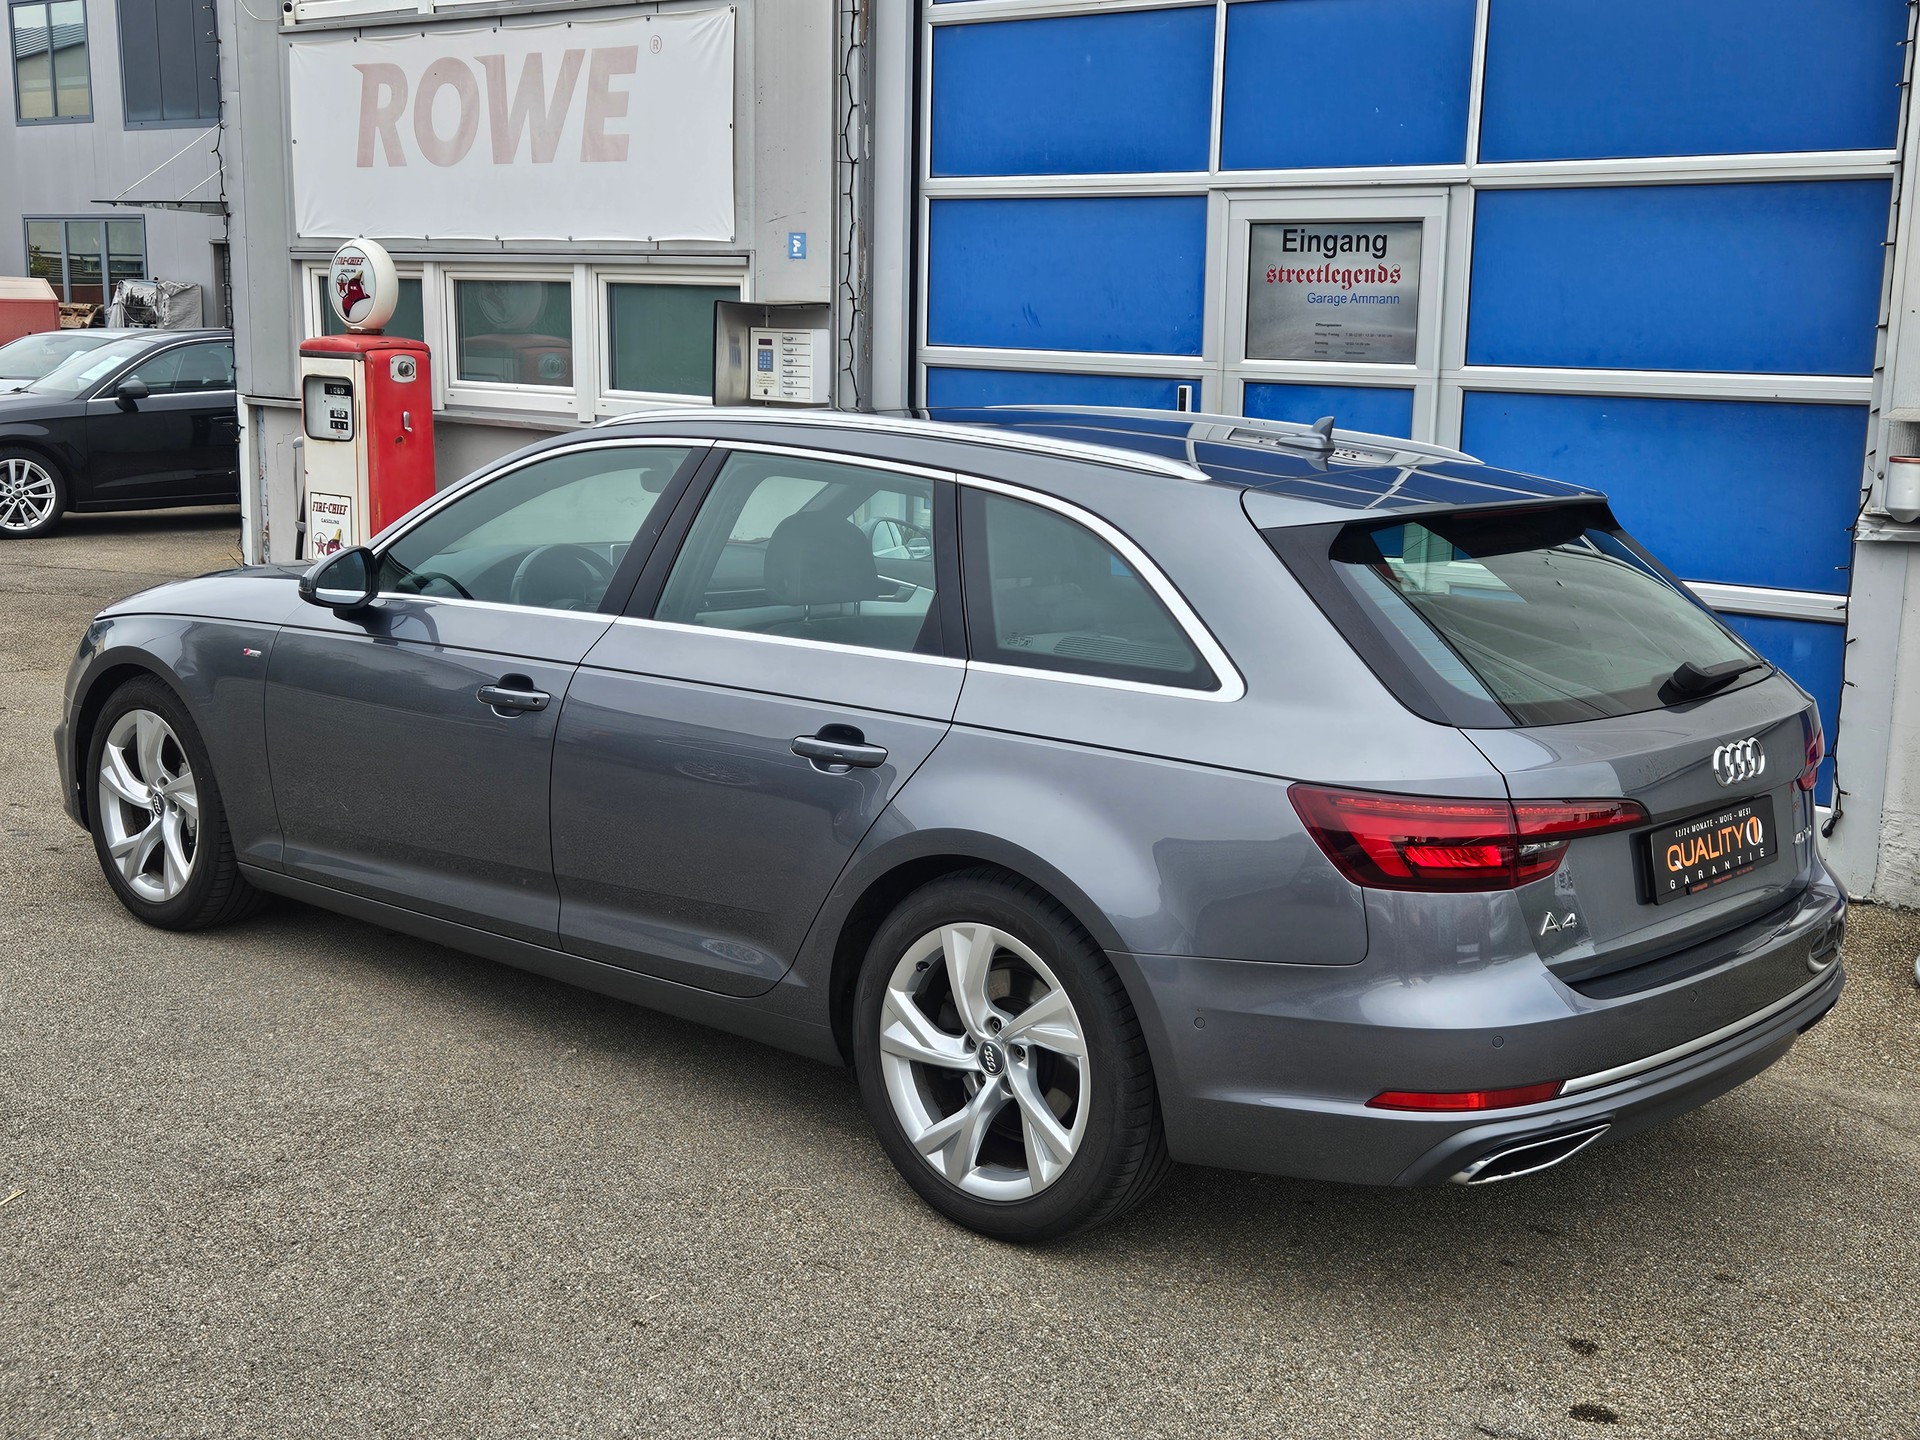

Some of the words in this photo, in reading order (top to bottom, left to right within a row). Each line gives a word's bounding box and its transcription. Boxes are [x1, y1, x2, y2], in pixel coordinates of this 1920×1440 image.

[352, 45, 639, 168] ROWE
[1281, 228, 1388, 259] Eingang
[1266, 262, 1402, 291] streetlegends
[1306, 292, 1347, 307] Garage
[1349, 292, 1400, 305] Ammann
[312, 501, 348, 515] FIRE-CHIEF
[1691, 819, 1714, 833] MONATE
[1719, 812, 1733, 824] MOIS
[1738, 807, 1751, 817] MESI
[1667, 822, 1744, 872] QUALITY
[1670, 847, 1765, 890] GARANTIE
[1540, 911, 1578, 936] A4
